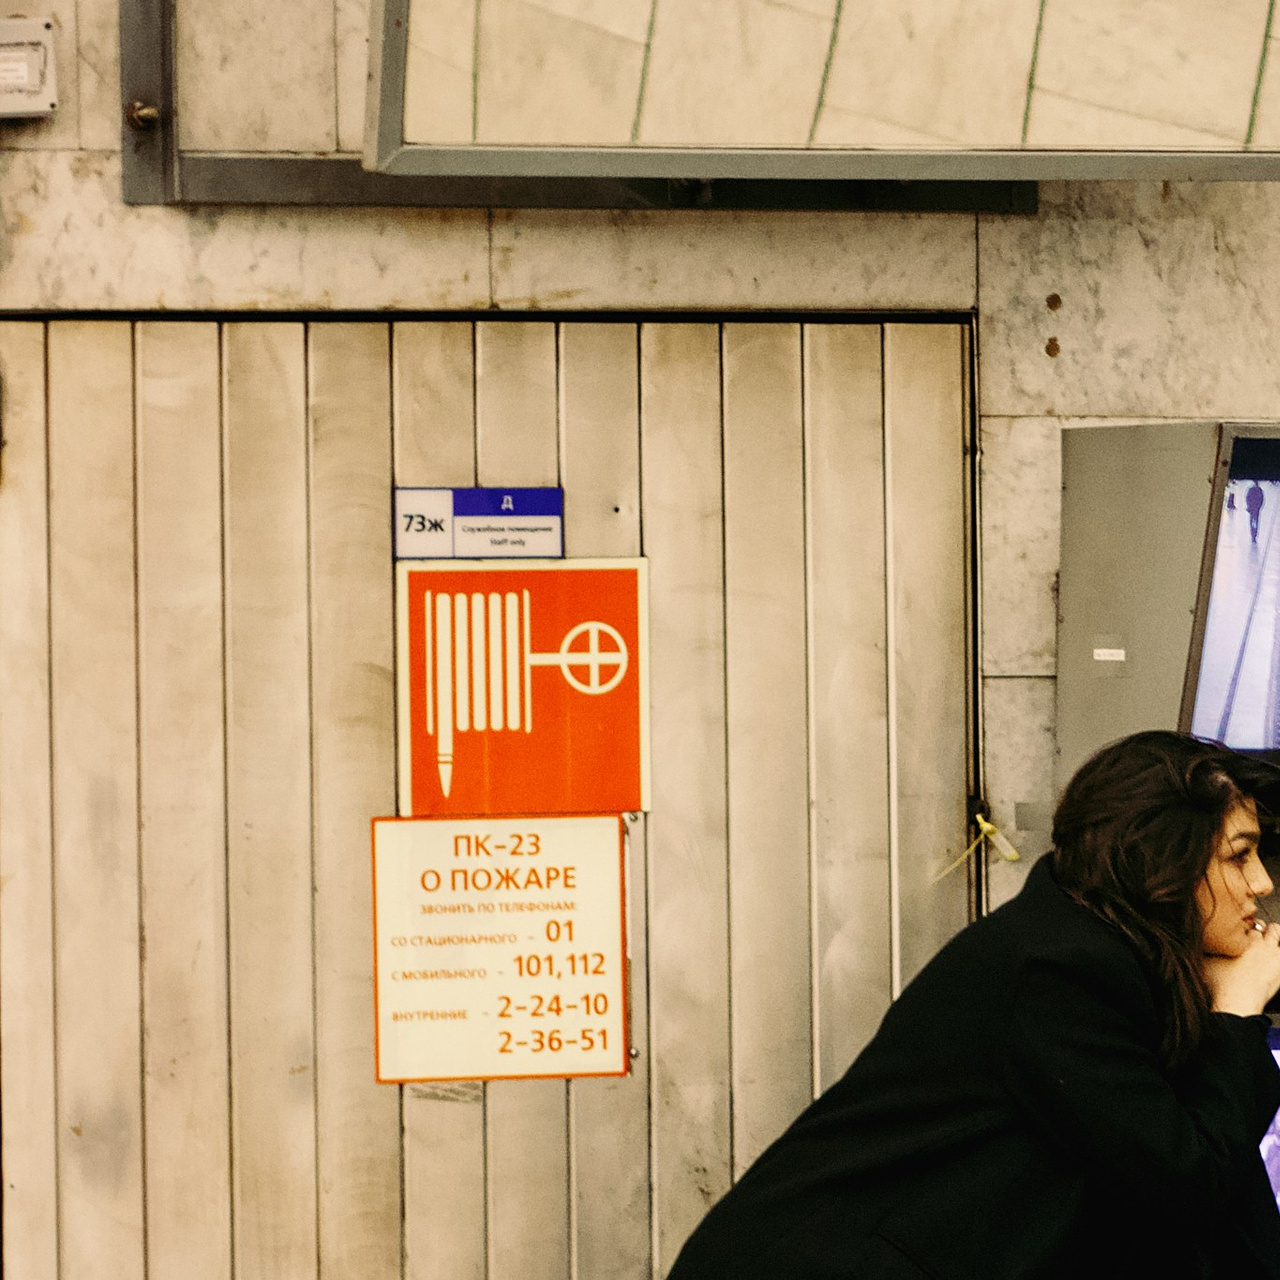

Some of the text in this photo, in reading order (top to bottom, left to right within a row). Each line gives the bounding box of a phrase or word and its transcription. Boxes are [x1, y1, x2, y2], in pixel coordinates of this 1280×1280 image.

[402, 514, 445, 533] 73ж
[453, 833, 541, 858] ПК-23
[420, 865, 577, 893] О ПОЖАРЕ
[420, 902, 475, 915] ЗВОНИТЬ
[477, 902, 495, 913] ПО
[391, 936, 407, 947] СО
[410, 933, 518, 947] СТАЦИОНАРНОГО
[545, 919, 575, 943] 01
[391, 971, 400, 982] С
[401, 967, 487, 981] МОБИЛЬНОГО
[513, 951, 606, 980] 101,112
[392, 1009, 469, 1022] ВНУТРЕННИЕ
[497, 992, 609, 1019] 2-24-10
[498, 1028, 609, 1054] 2-36-51
